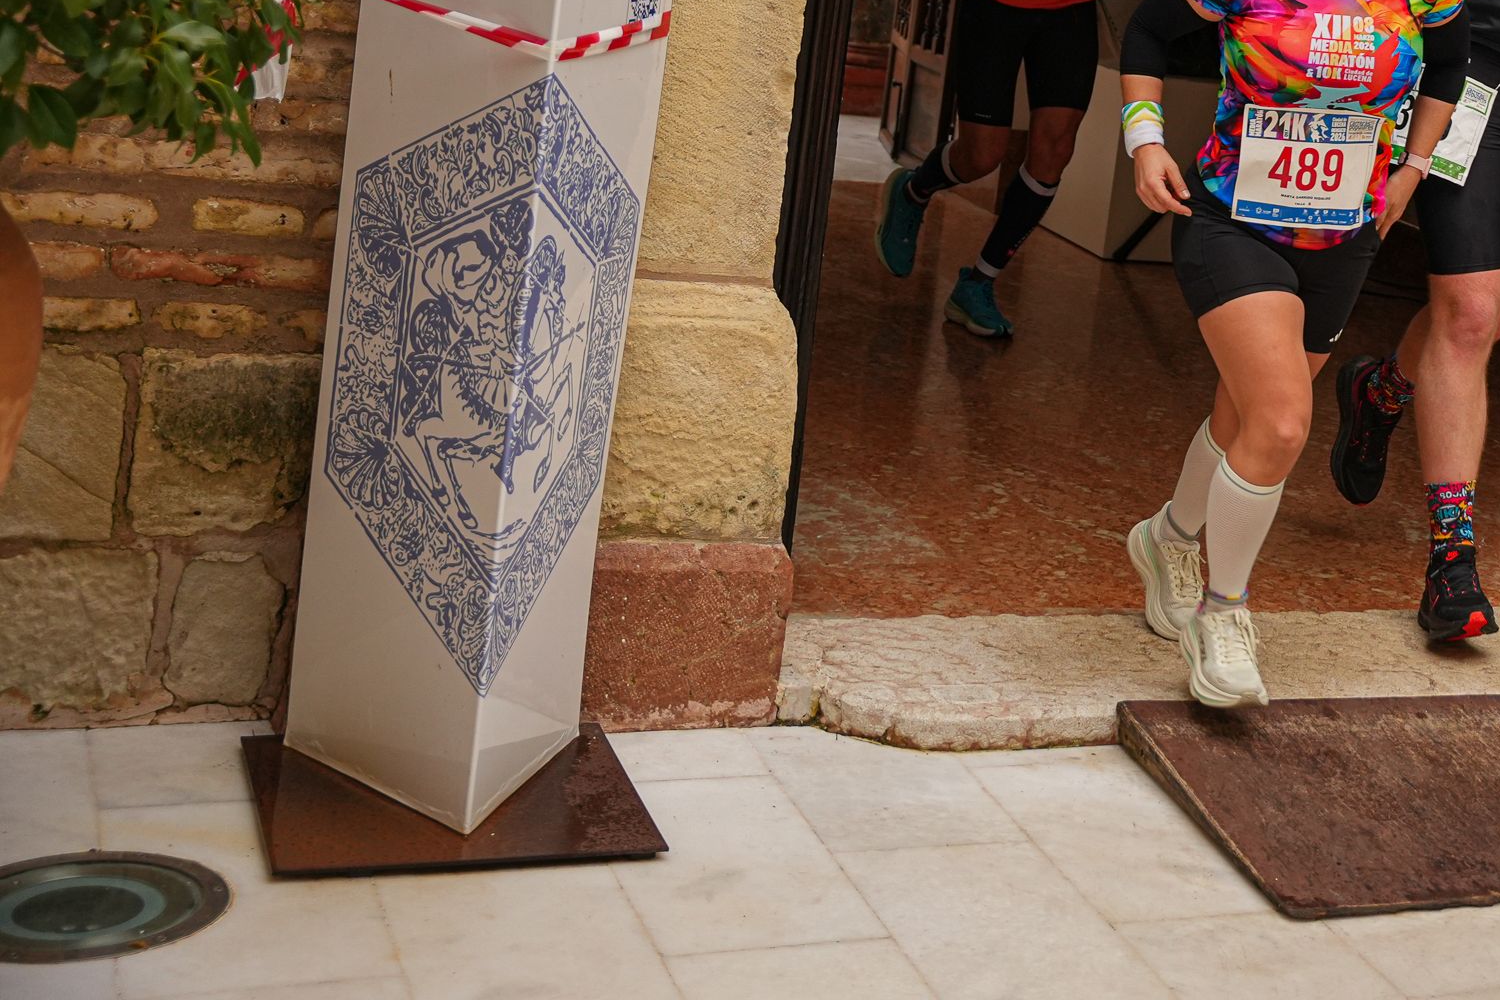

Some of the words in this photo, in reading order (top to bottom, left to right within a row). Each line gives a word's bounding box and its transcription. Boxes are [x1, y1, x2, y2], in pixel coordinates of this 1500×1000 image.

[1312, 13, 1351, 40] XII
[1352, 16, 1375, 33] 08
[1310, 38, 1353, 54] MEDIA
[1353, 41, 1375, 51] 2026
[1308, 51, 1376, 69] MARATÓN
[1306, 68, 1314, 78] &
[1316, 66, 1342, 79] 10K
[1343, 74, 1373, 83] LUCENA
[1264, 110, 1308, 141] 21K
[1268, 146, 1344, 192] 489
